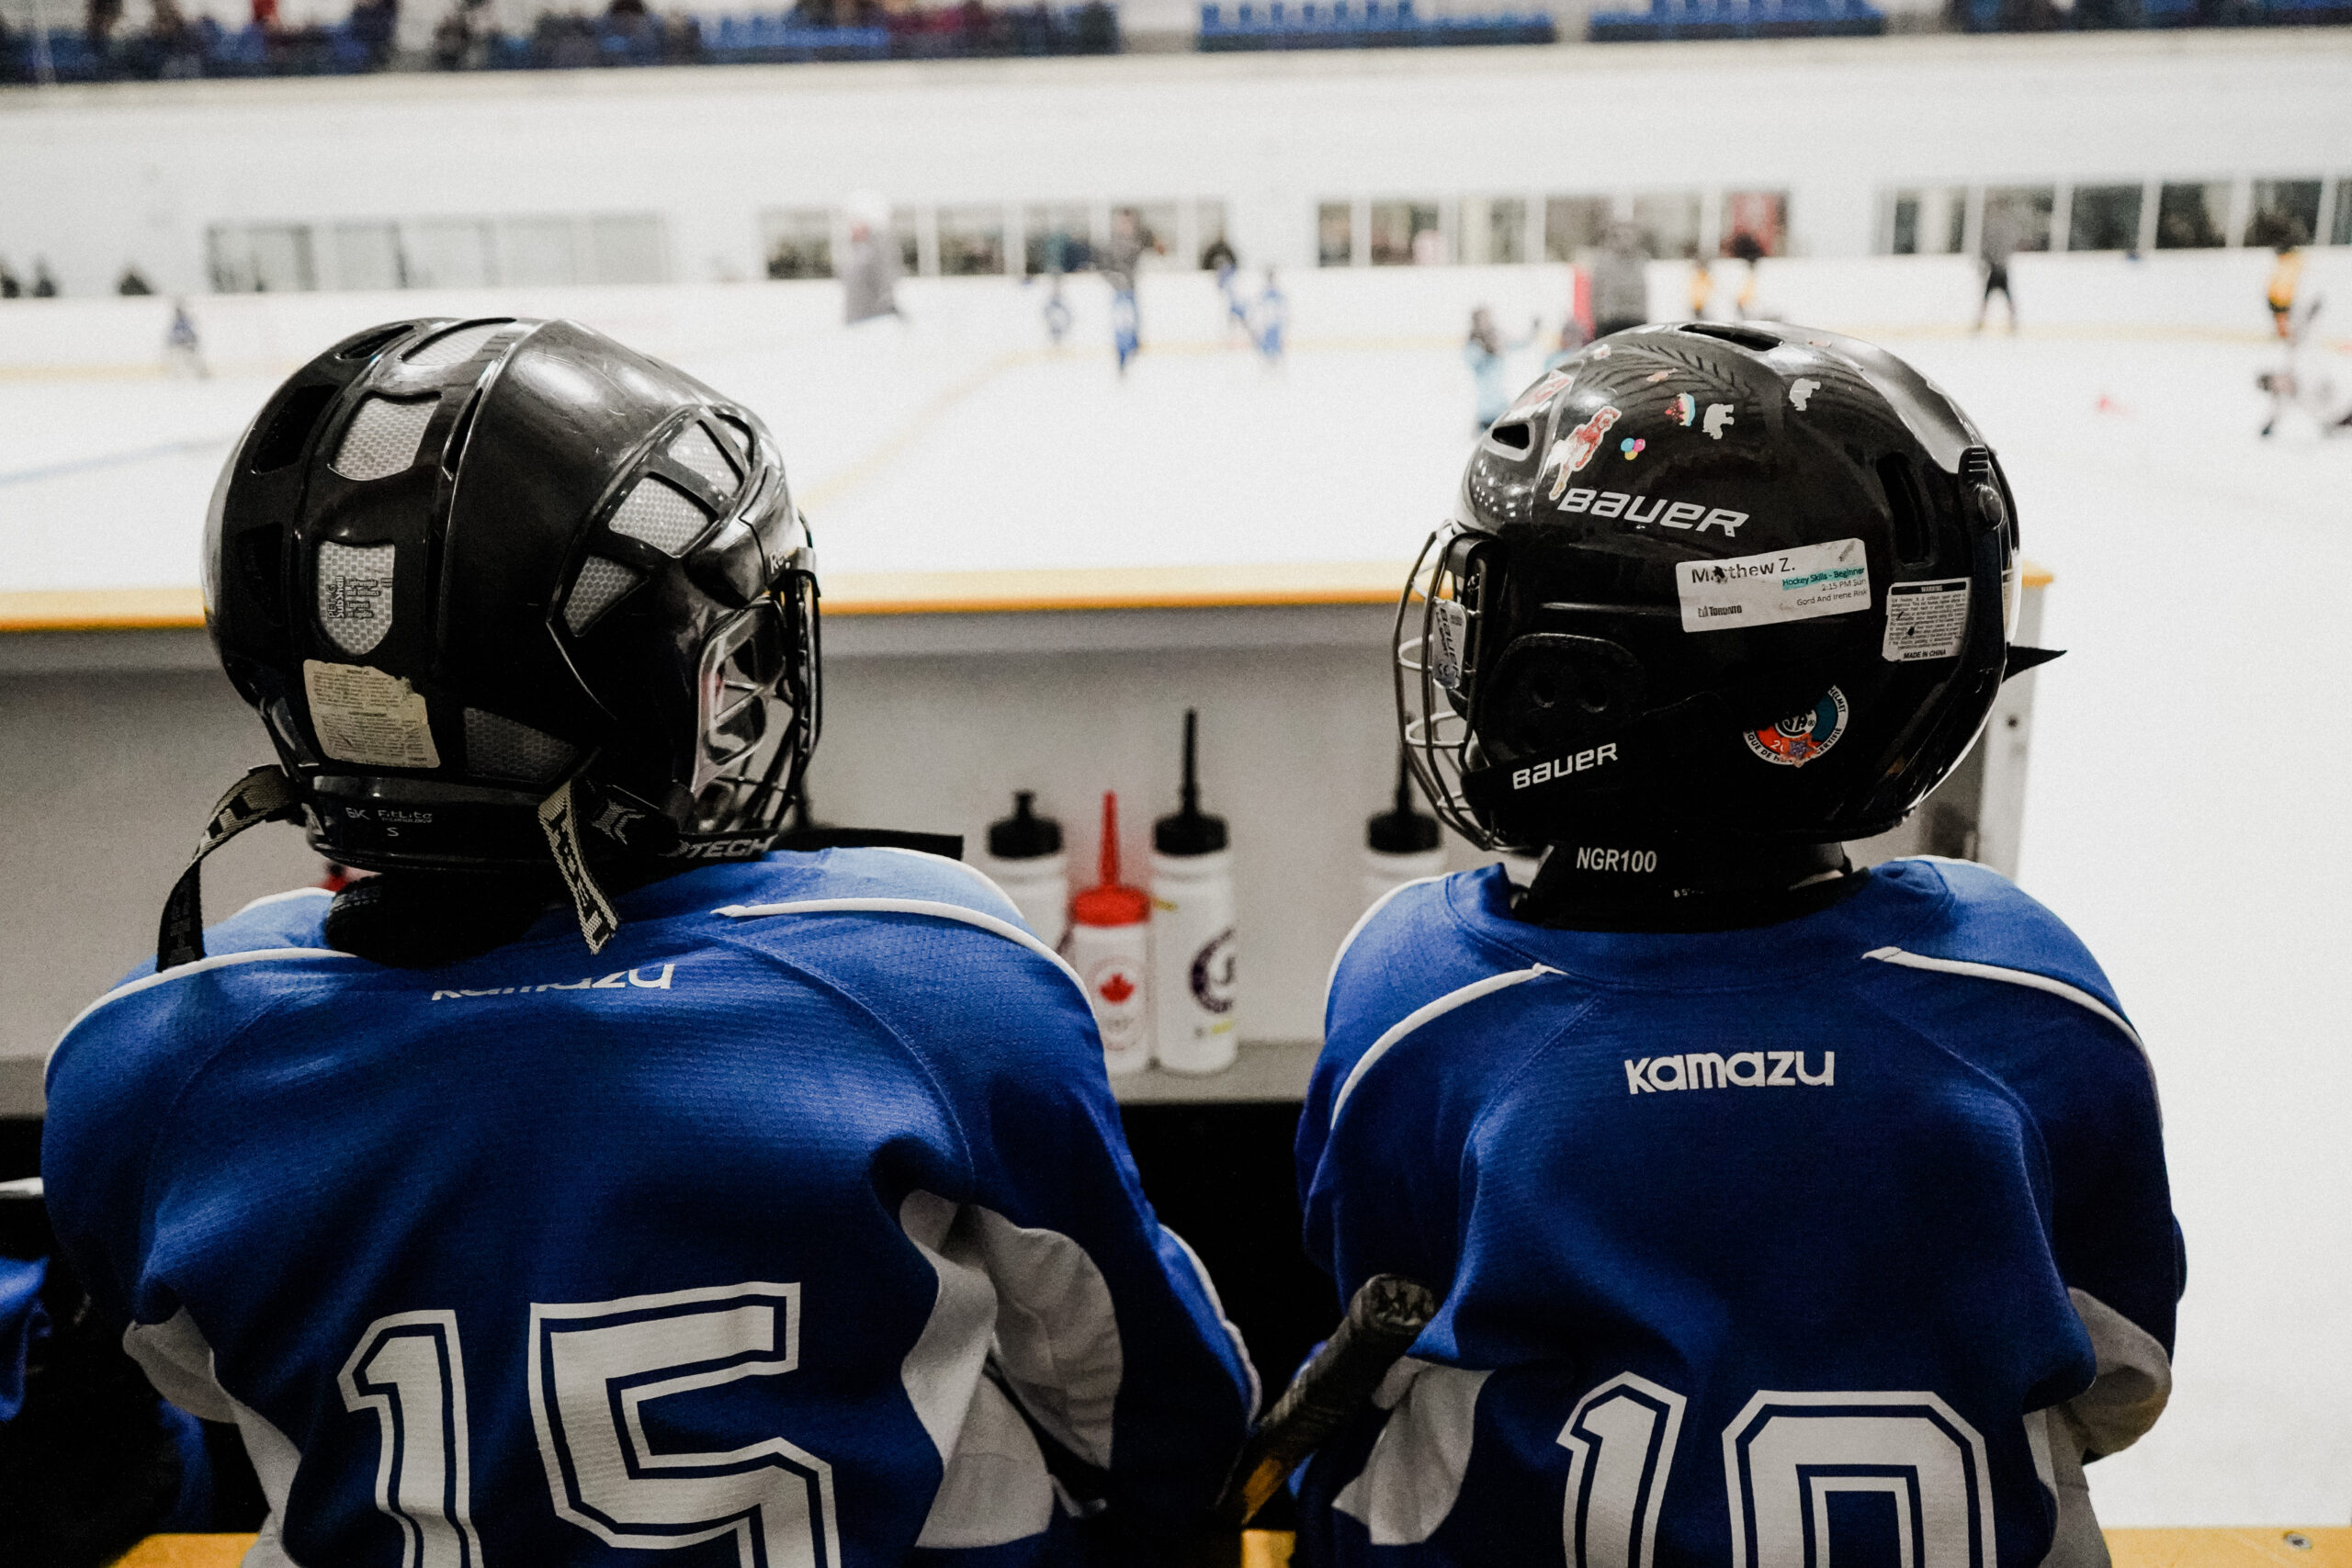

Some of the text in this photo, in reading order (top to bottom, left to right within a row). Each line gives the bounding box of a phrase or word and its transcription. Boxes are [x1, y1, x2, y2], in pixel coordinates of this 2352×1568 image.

[1691, 558, 1795, 583] Mthew Z.
[1782, 577, 1809, 586] Hockey
[1810, 573, 1827, 582] Skills
[1834, 568, 1864, 578] Beginner
[1797, 597, 1815, 605] Gord
[1817, 594, 1831, 603] And
[1833, 592, 1851, 600] Irene
[1709, 605, 1742, 616] TORONTO
[1929, 649, 1946, 657] CHINA
[387, 827, 399, 837] S
[1577, 847, 1657, 873] NGR100
[1624, 1051, 1835, 1094] kamazu
[337, 1281, 841, 1568] 15
